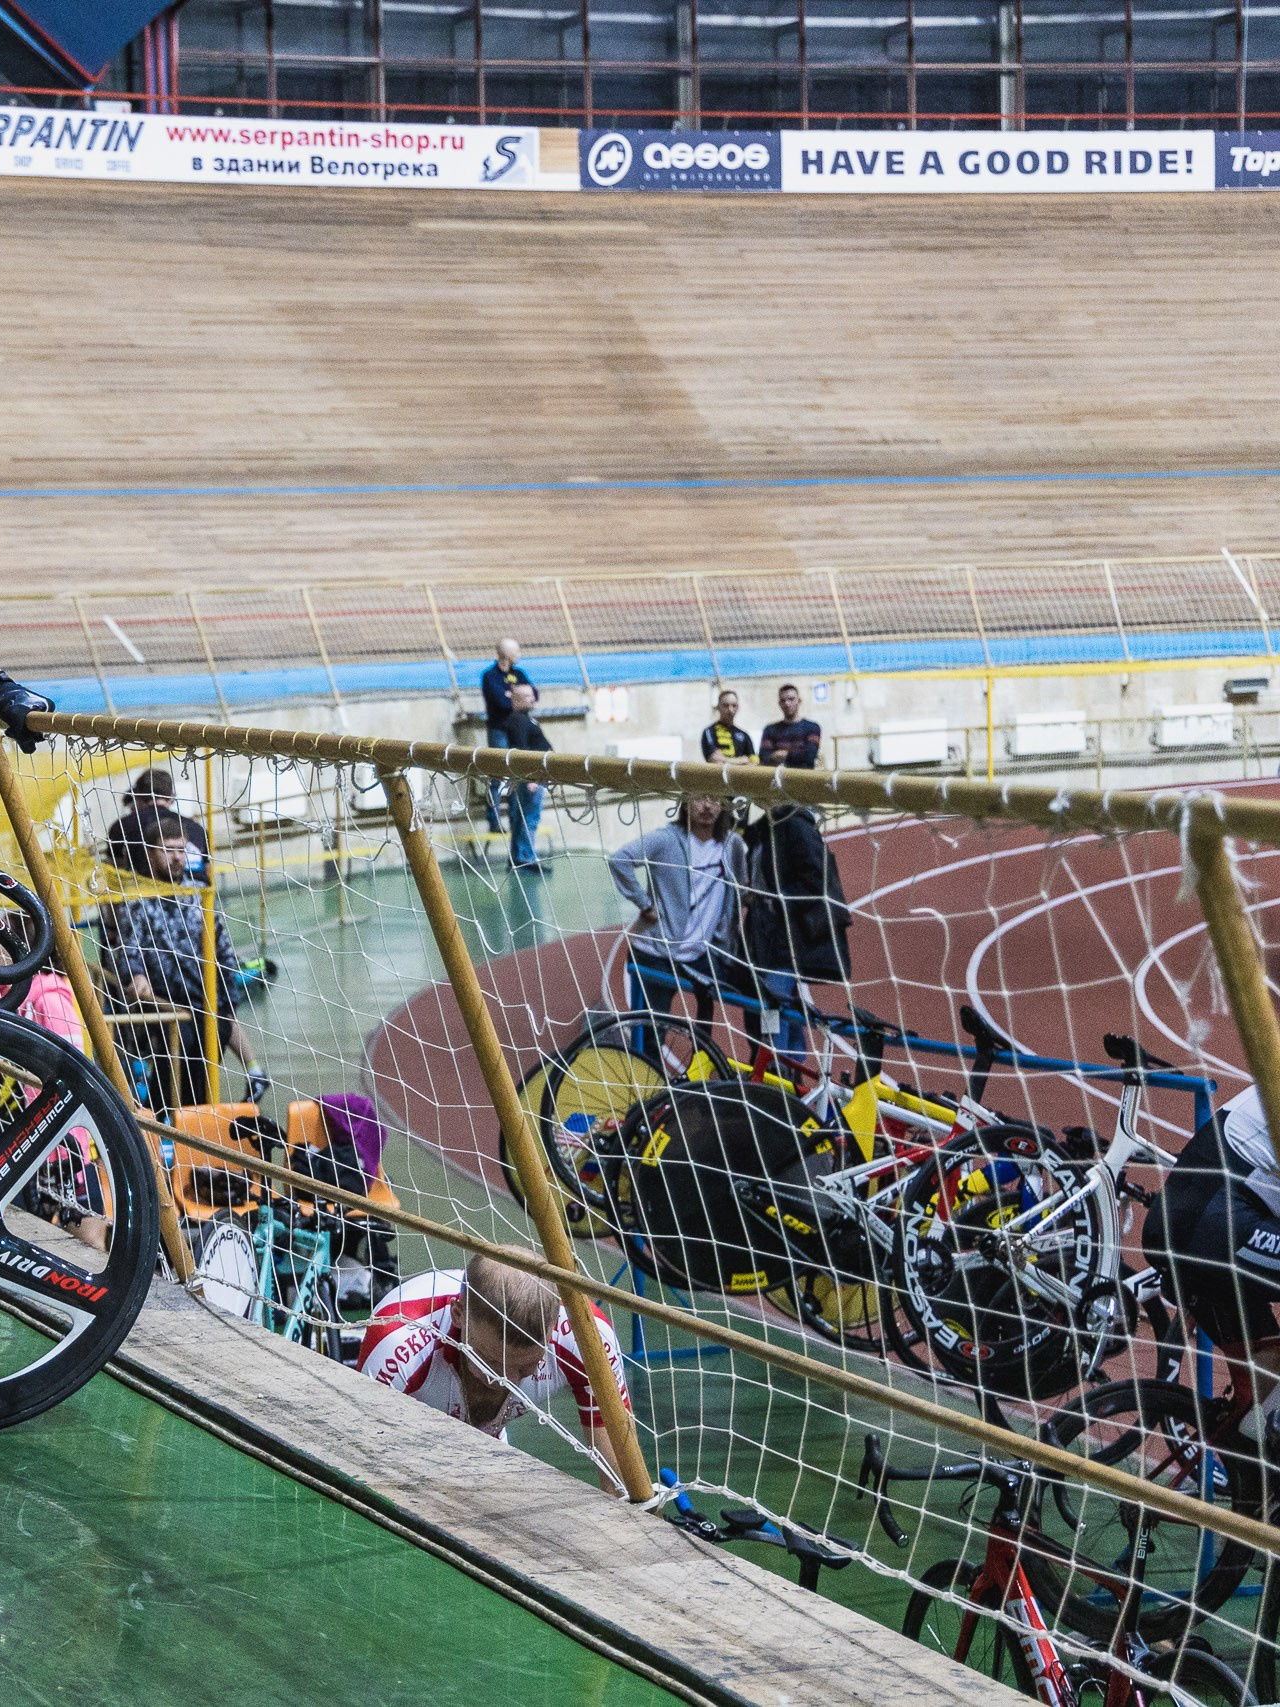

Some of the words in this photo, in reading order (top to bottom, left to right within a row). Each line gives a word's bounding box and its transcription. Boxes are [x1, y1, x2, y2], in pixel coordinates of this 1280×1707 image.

[166, 126, 464, 154] www.serpantin-shop.ru
[213, 158, 301, 176] здании
[311, 155, 438, 179] Велотрека
[801, 150, 905, 176] HAVE
[919, 150, 944, 175] A
[958, 150, 1069, 175] GOOD
[1084, 149, 1194, 175] RIDE!
[11, 1089, 73, 1163] POWERED
